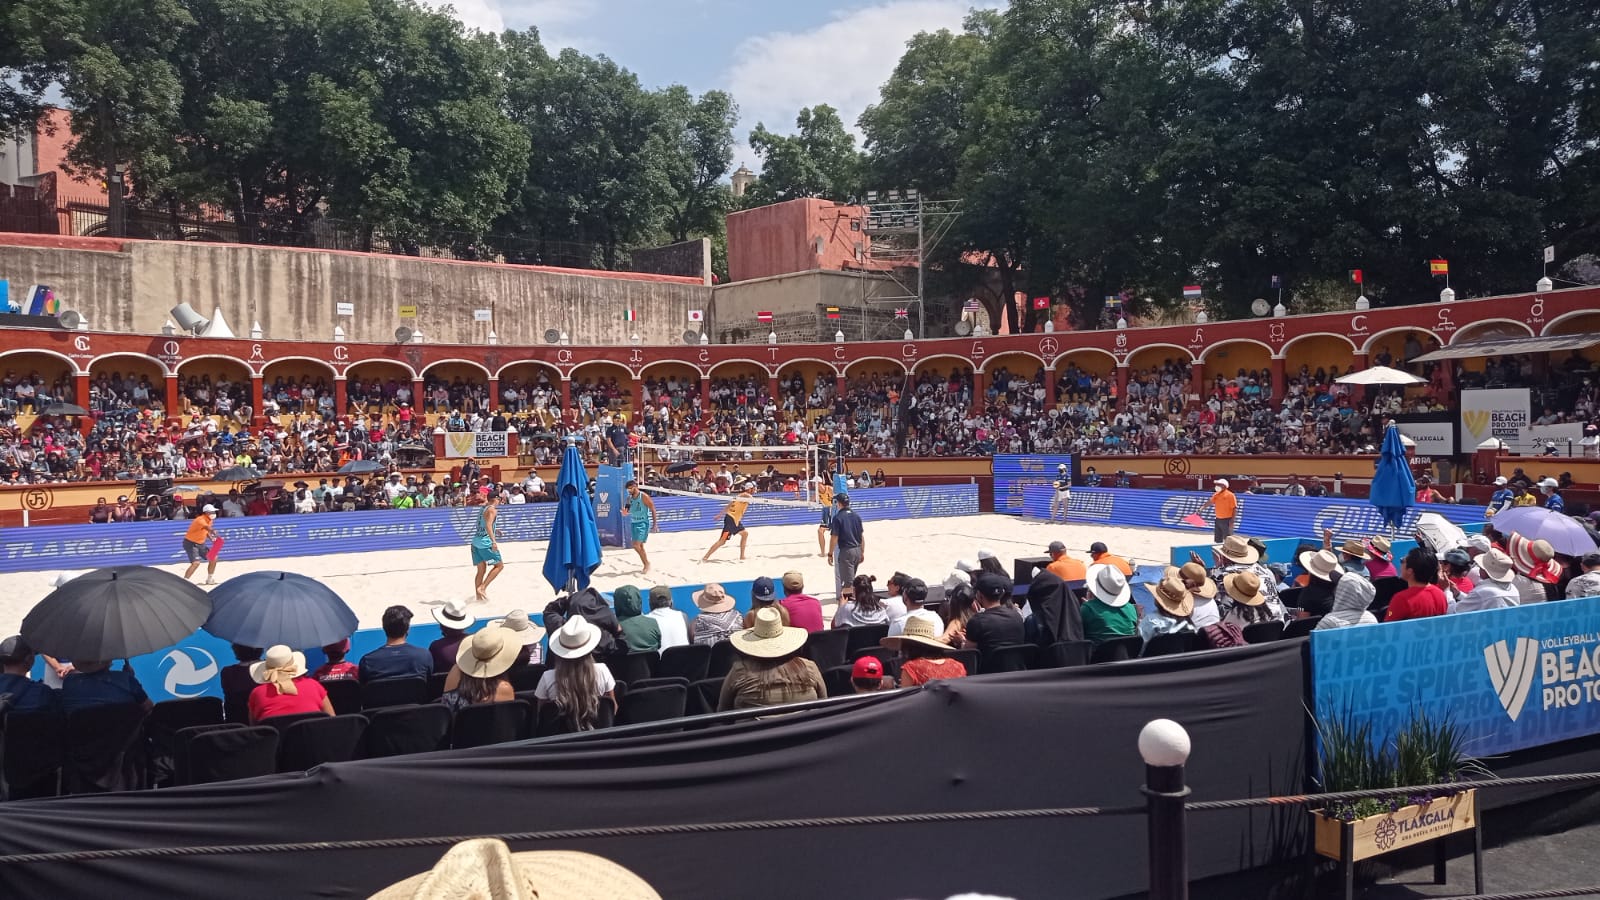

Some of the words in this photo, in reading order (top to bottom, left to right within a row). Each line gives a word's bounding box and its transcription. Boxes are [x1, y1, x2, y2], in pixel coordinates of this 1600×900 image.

[1491, 413, 1526, 421] BEACH
[931, 493, 979, 507] BEACH
[308, 524, 418, 541] VOLLEYBALL
[421, 522, 446, 535] TV
[5, 538, 149, 559] TLAXCALA
[1541, 632, 1596, 650] VOLLEYBALL
[1543, 682, 1581, 712] PRO
[1397, 808, 1455, 834] TLAXCALA
